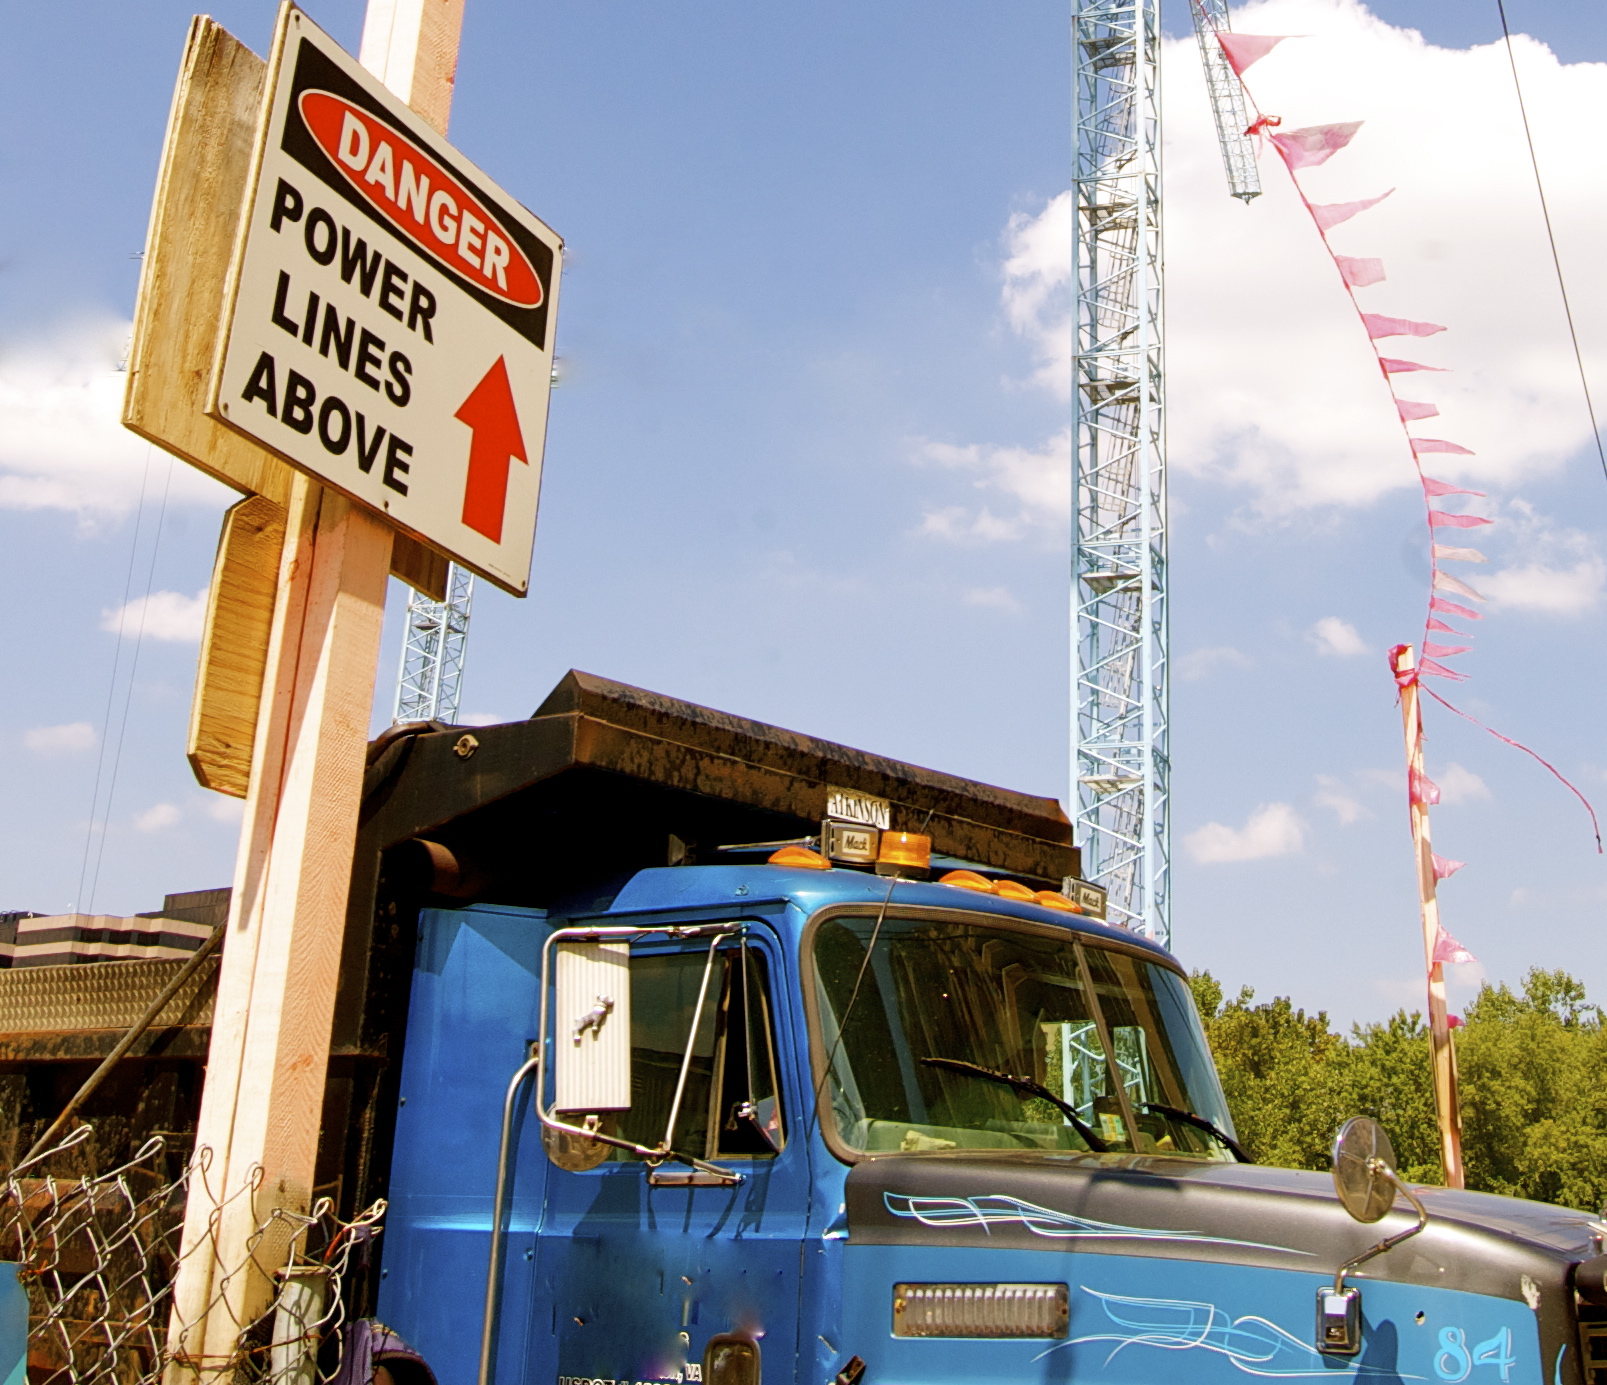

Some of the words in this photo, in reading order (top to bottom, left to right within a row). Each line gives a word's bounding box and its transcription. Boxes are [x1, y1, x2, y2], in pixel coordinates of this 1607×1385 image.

[270, 177, 437, 345] POWER
[337, 110, 510, 291] DANGER
[271, 269, 413, 408] LINES
[241, 351, 414, 497] ABOVE
[844, 834, 868, 851] Mack
[1433, 1326, 1516, 1383] 84
